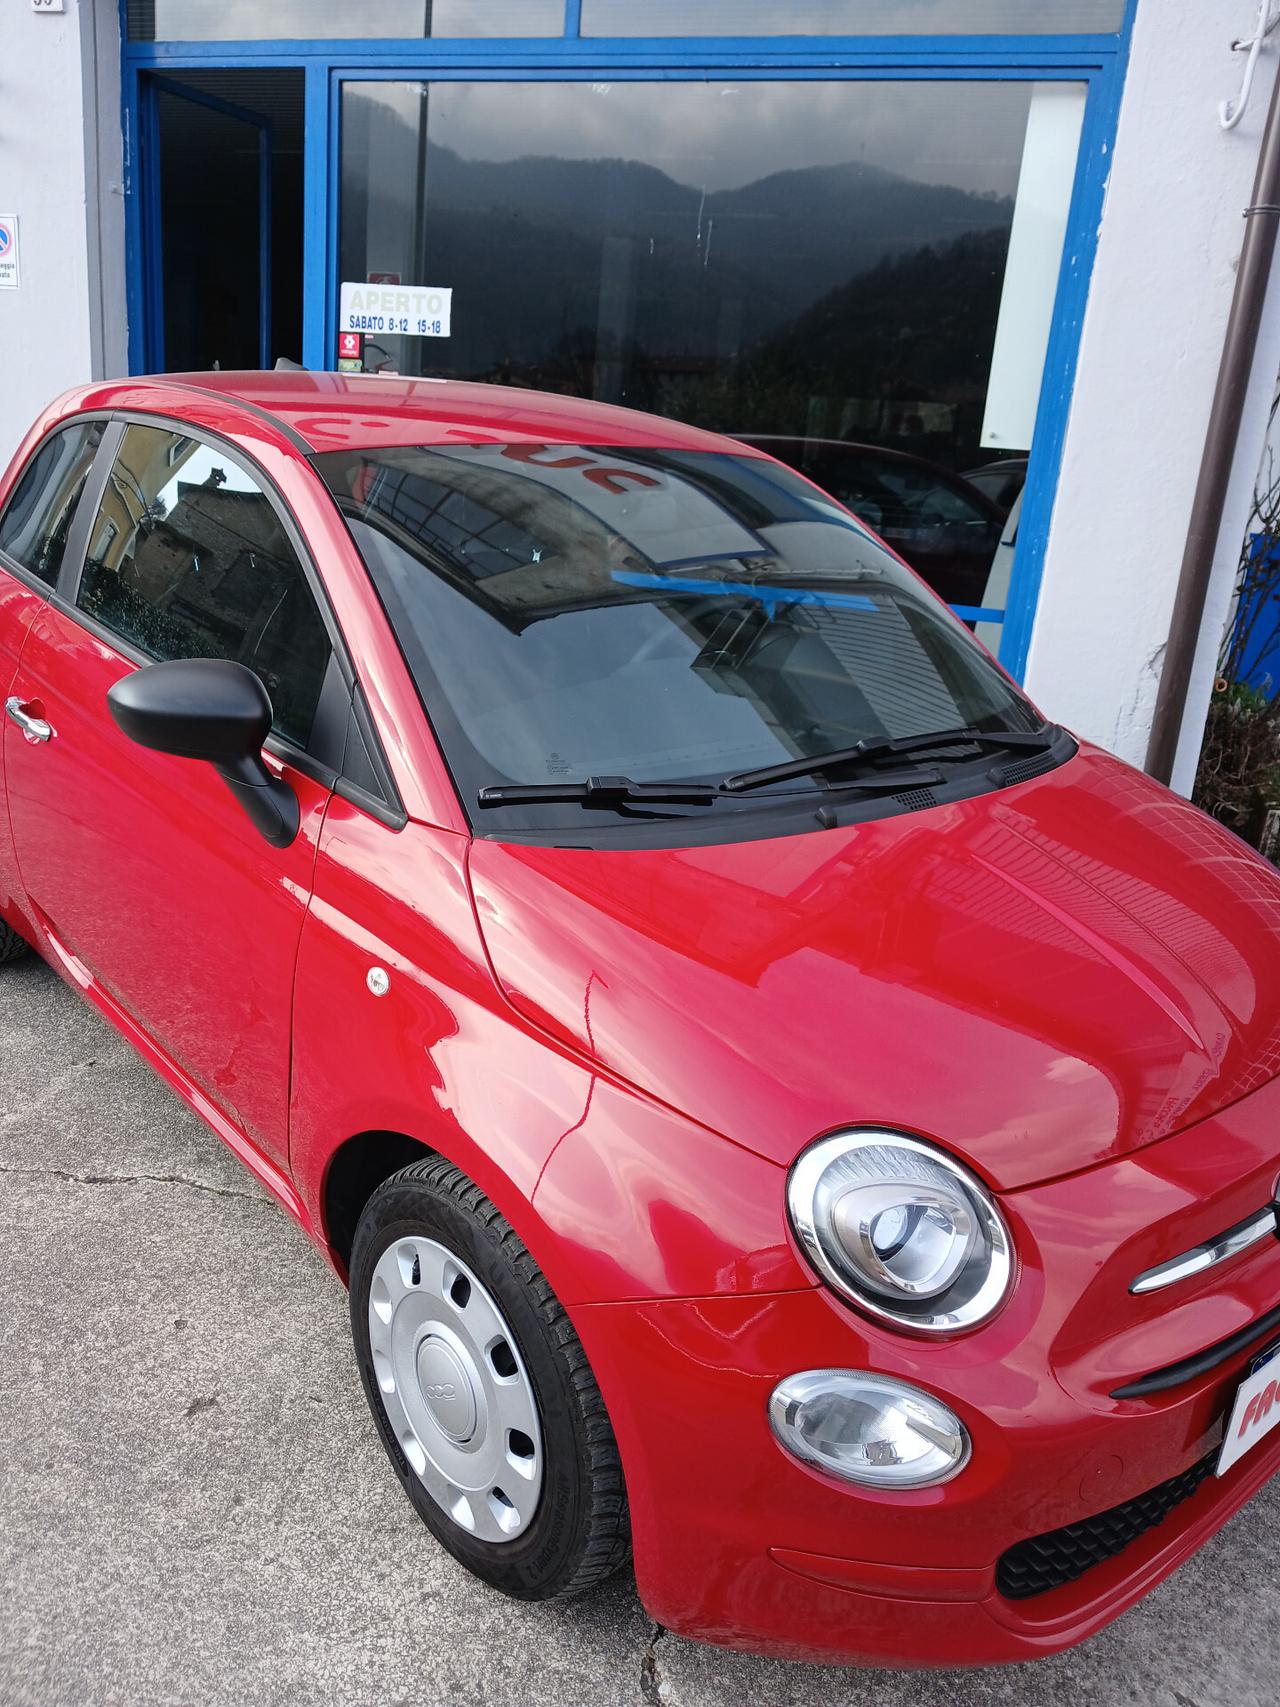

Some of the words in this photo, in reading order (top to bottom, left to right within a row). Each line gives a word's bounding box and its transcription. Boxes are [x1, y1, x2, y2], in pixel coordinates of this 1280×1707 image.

[349, 290, 443, 314] APERTO
[349, 315, 384, 330] SABATO
[388, 317, 408, 332] 8-12
[417, 320, 441, 333] 15-18
